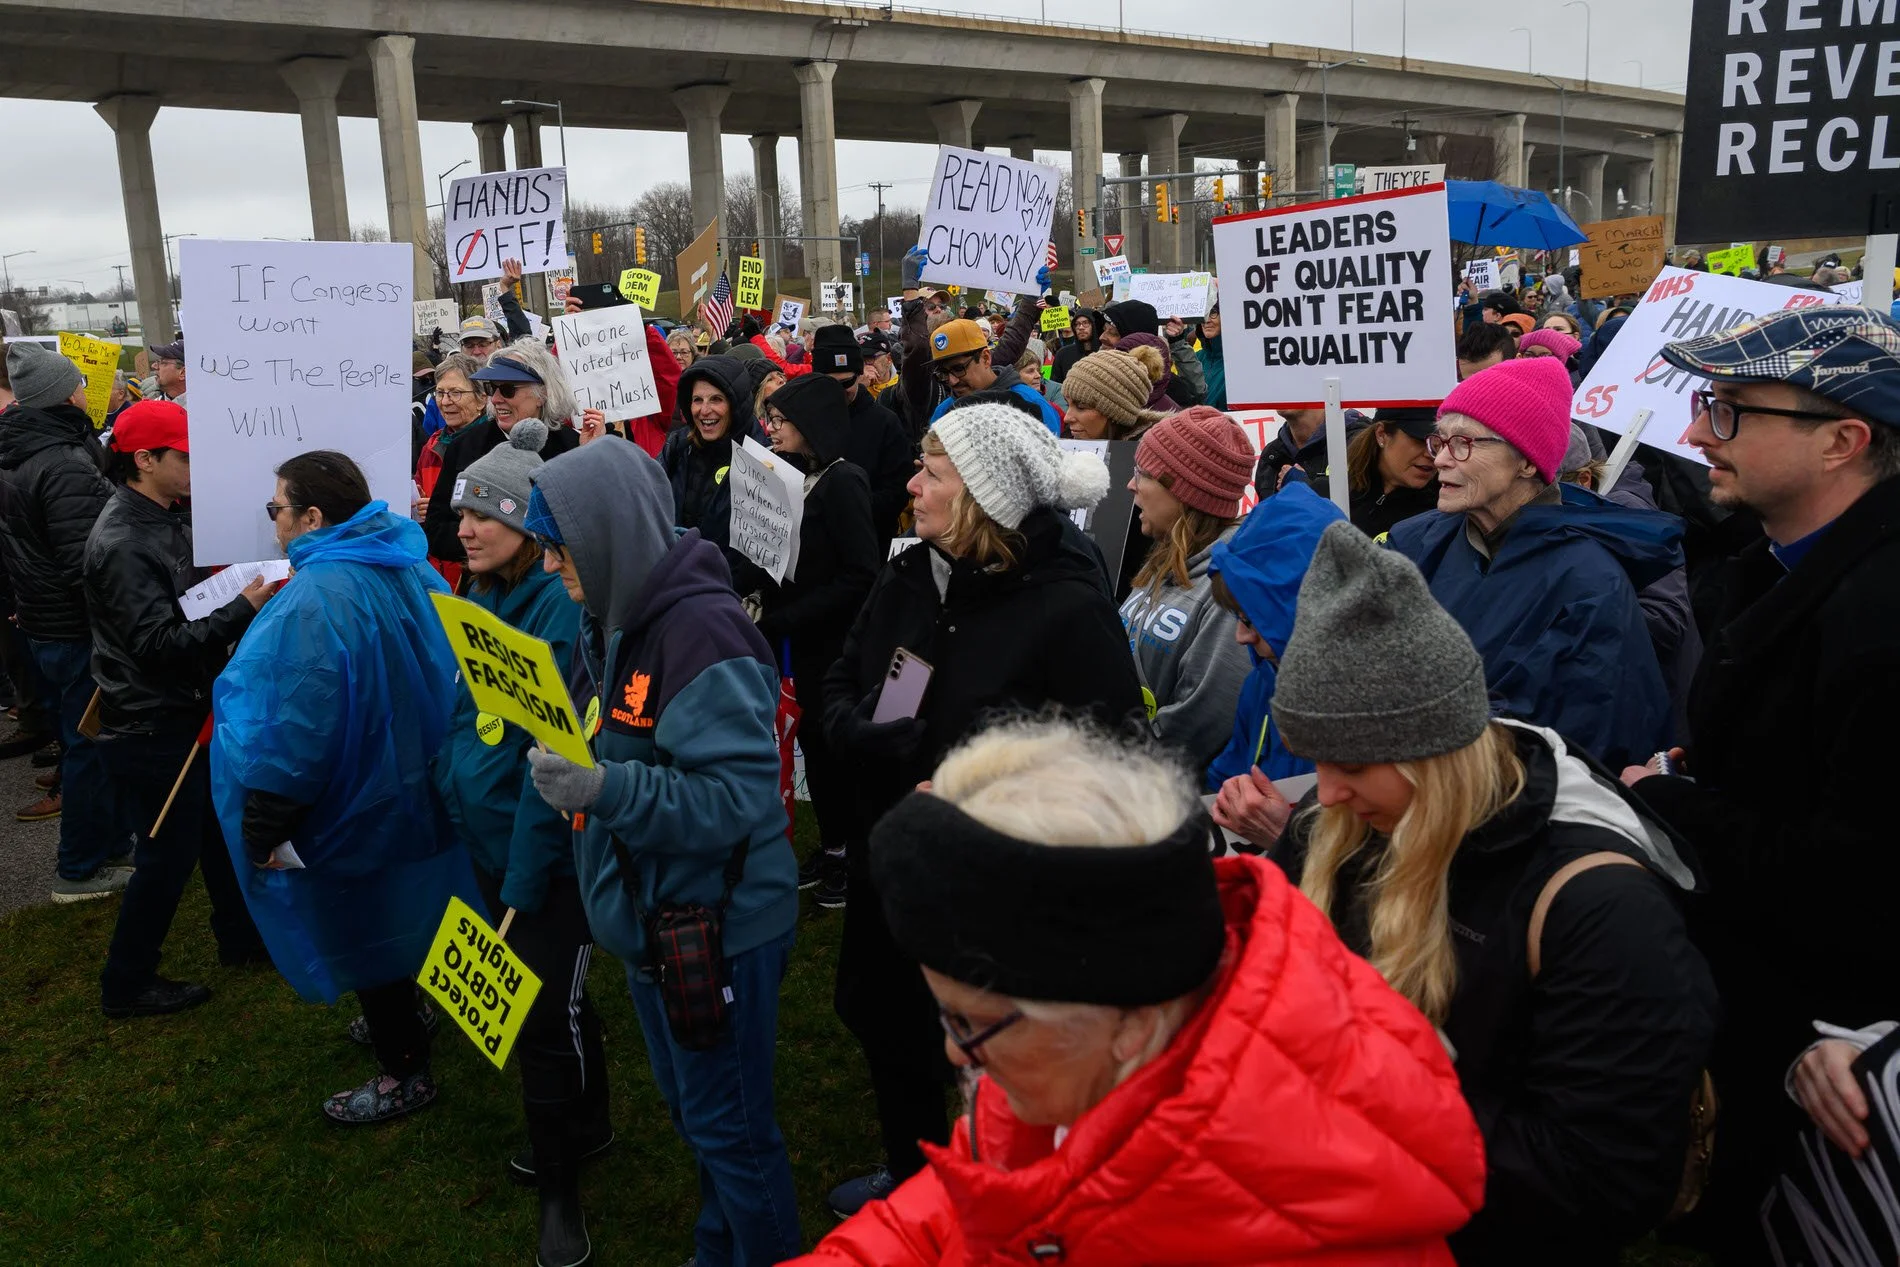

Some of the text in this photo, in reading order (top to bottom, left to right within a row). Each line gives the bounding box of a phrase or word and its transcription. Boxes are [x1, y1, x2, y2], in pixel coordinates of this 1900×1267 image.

[453, 173, 552, 221] HANDS
[938, 154, 1012, 213] READ
[1255, 210, 1397, 258] LEADERS
[742, 260, 762, 274] END
[926, 224, 1043, 283] CHOMSKY
[1111, 265, 1127, 273] OBEY
[1245, 249, 1432, 294] OF QUALITY
[231, 264, 403, 306] IF Congress
[625, 281, 649, 293] DEM
[627, 271, 652, 282] Grow
[741, 276, 761, 291] REX
[740, 291, 759, 306] LEX
[1045, 307, 1063, 315] HONK
[1243, 288, 1424, 330] DON'T FEAR
[561, 318, 629, 351] No one
[1042, 317, 1069, 325] Abortion
[618, 342, 643, 363] for
[1263, 331, 1413, 366] EQUALITY
[264, 358, 335, 386] The
[609, 376, 654, 408] Musk
[227, 404, 303, 442] Will!
[734, 446, 768, 487] Since
[744, 480, 788, 519] When do
[737, 532, 781, 573] NEVER
[460, 621, 542, 688] RESIST
[464, 657, 575, 735] FASCISM
[478, 718, 501, 738] RESIST
[611, 707, 654, 728] SCOTLAND
[457, 917, 523, 997] Rights
[444, 939, 511, 1026] LGBTQ
[429, 965, 503, 1057] Protect
